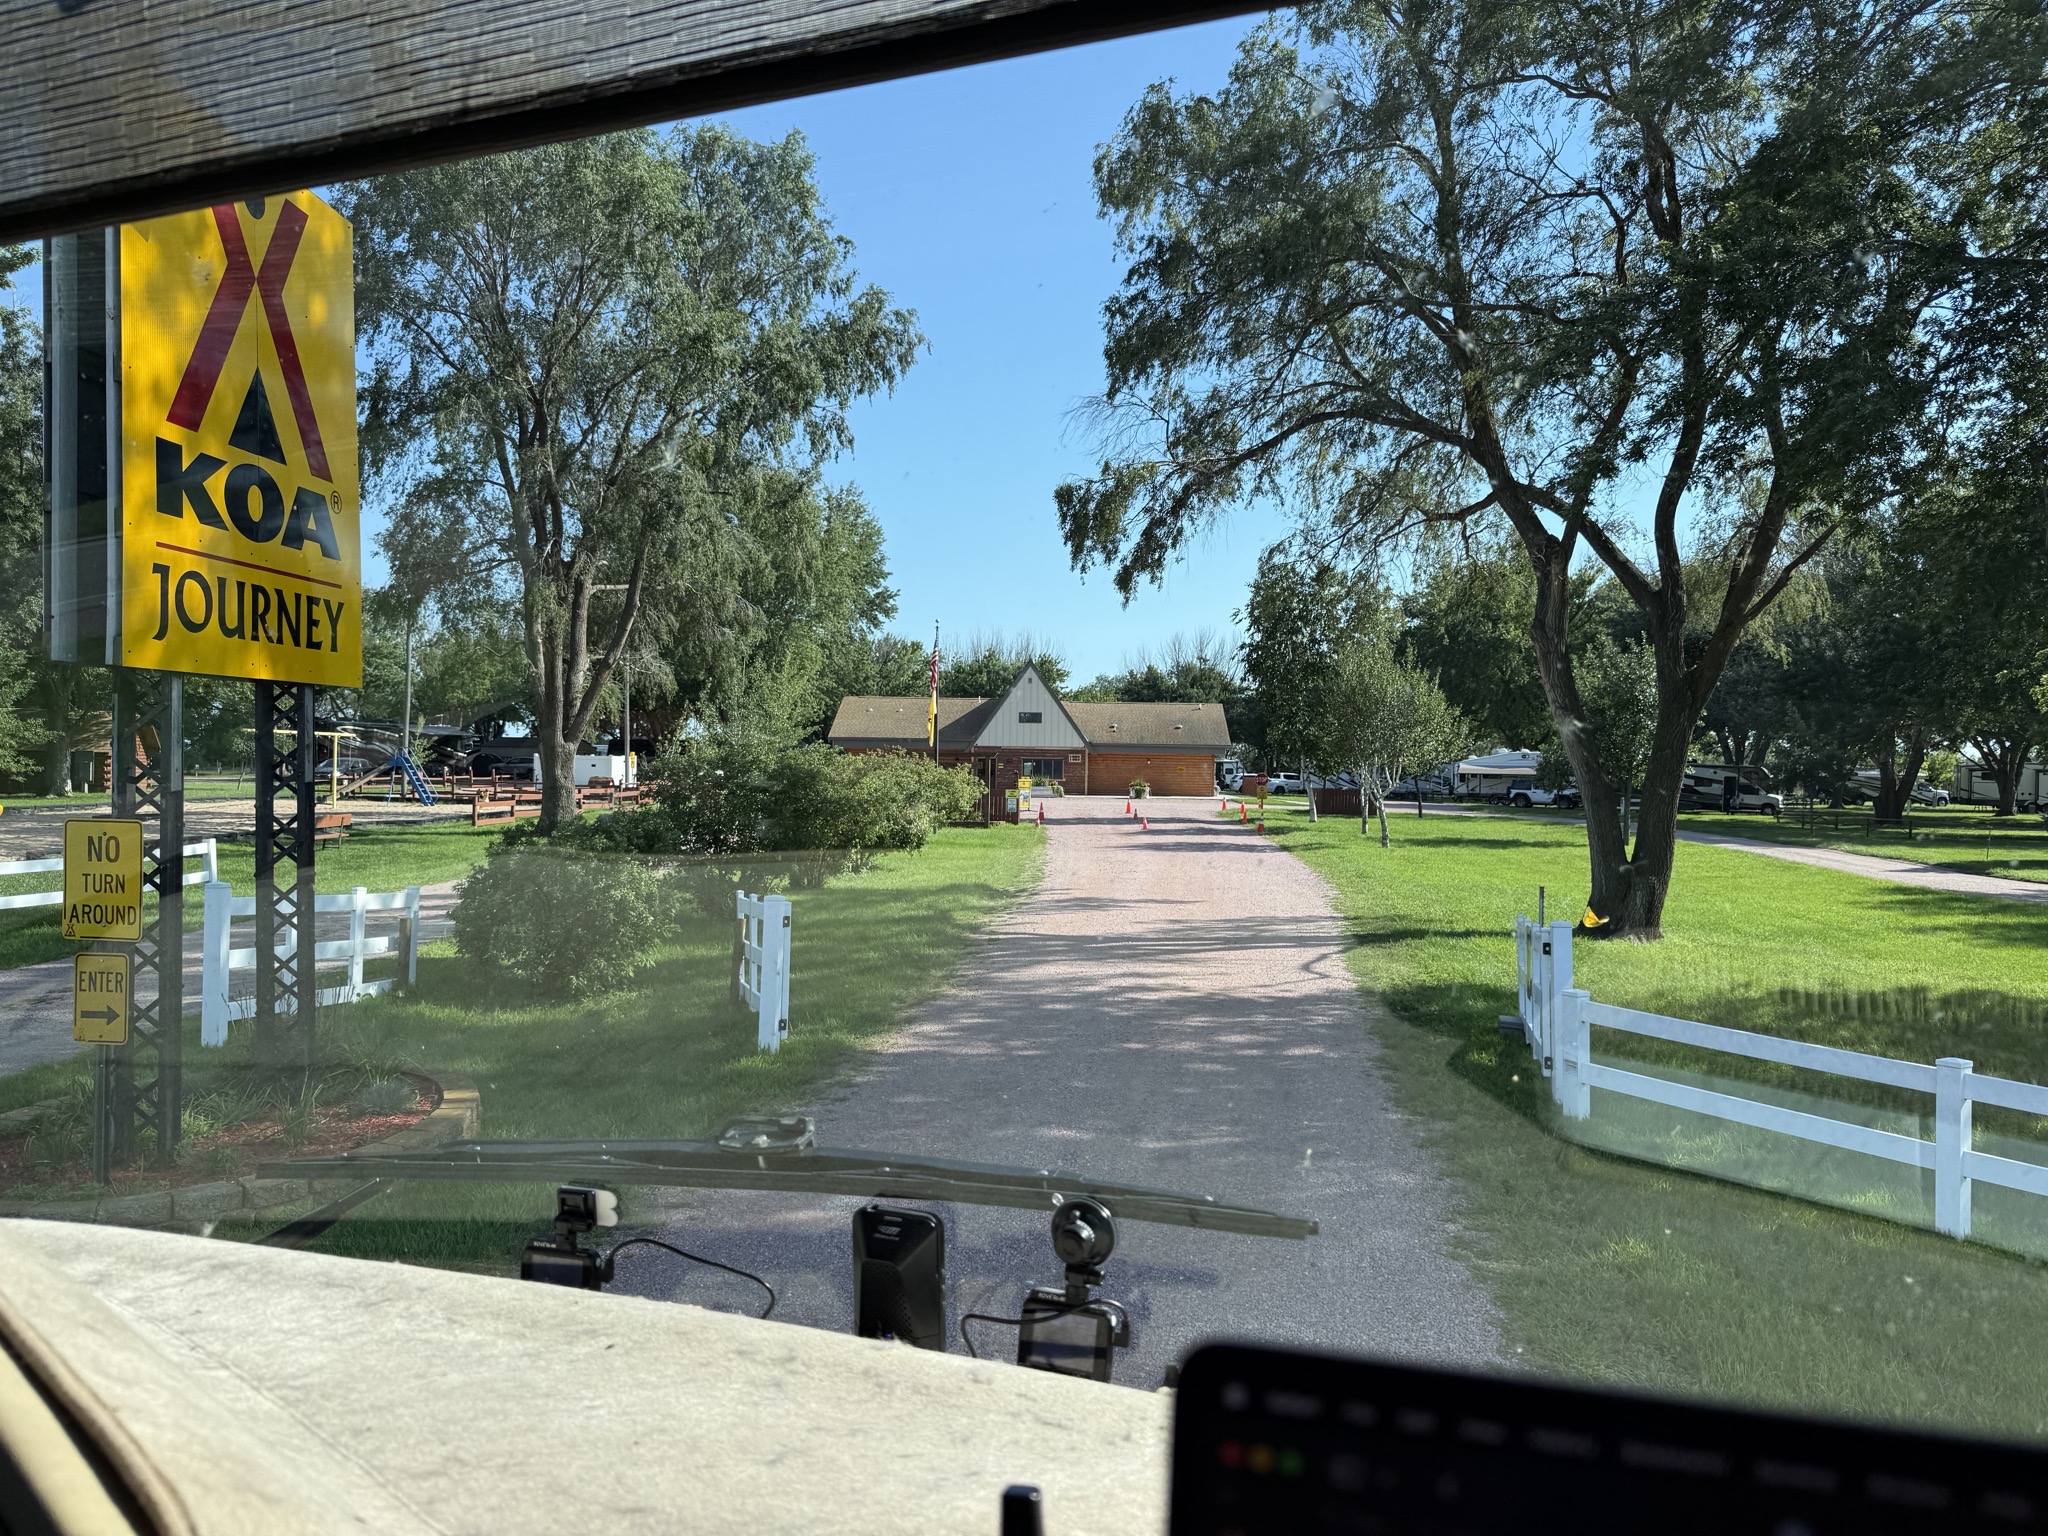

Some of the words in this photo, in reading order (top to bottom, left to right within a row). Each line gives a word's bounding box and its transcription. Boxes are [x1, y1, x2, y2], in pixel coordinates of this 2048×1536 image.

[156, 436, 342, 561] KOA
[152, 562, 345, 653] JOURNEY
[87, 835, 120, 863] NO
[82, 873, 125, 894] TURN
[69, 903, 137, 926] AROUND
[79, 970, 124, 993] ENTER
